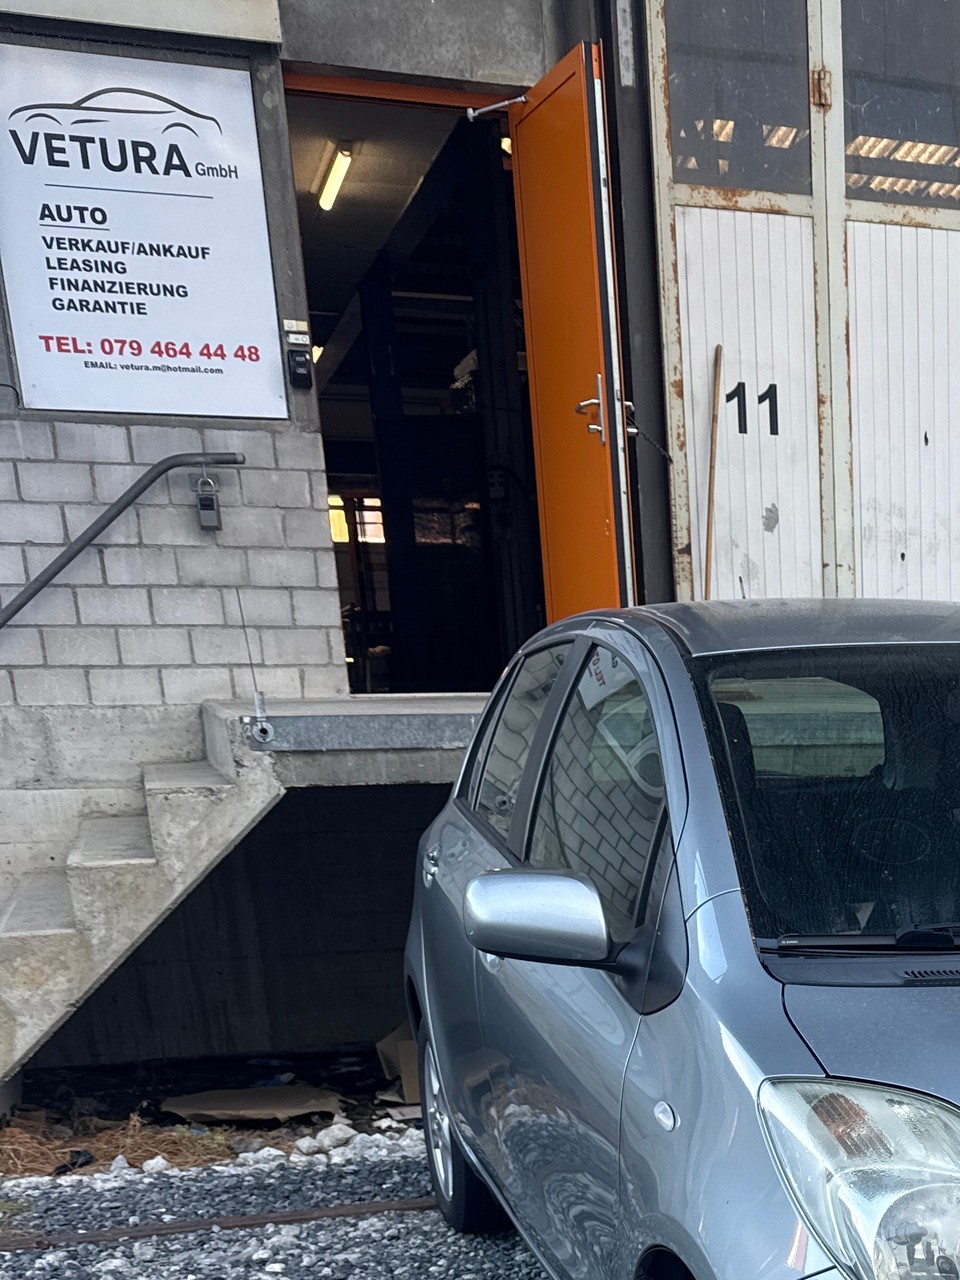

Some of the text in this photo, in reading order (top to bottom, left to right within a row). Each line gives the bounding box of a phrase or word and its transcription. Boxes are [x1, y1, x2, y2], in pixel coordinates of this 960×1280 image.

[8, 129, 239, 180] VETURA GmbH
[39, 203, 108, 225] AUTO
[41, 235, 211, 260] VERKAUF/ANKAUF
[45, 256, 128, 275] LEASING
[48, 276, 189, 298] FINANZIERUNG
[51, 296, 148, 316] GARANTIE
[38, 335, 261, 363] TEL: 079 464 44 48
[83, 360, 118, 370] EMAIL:
[725, 381, 779, 436] 11
